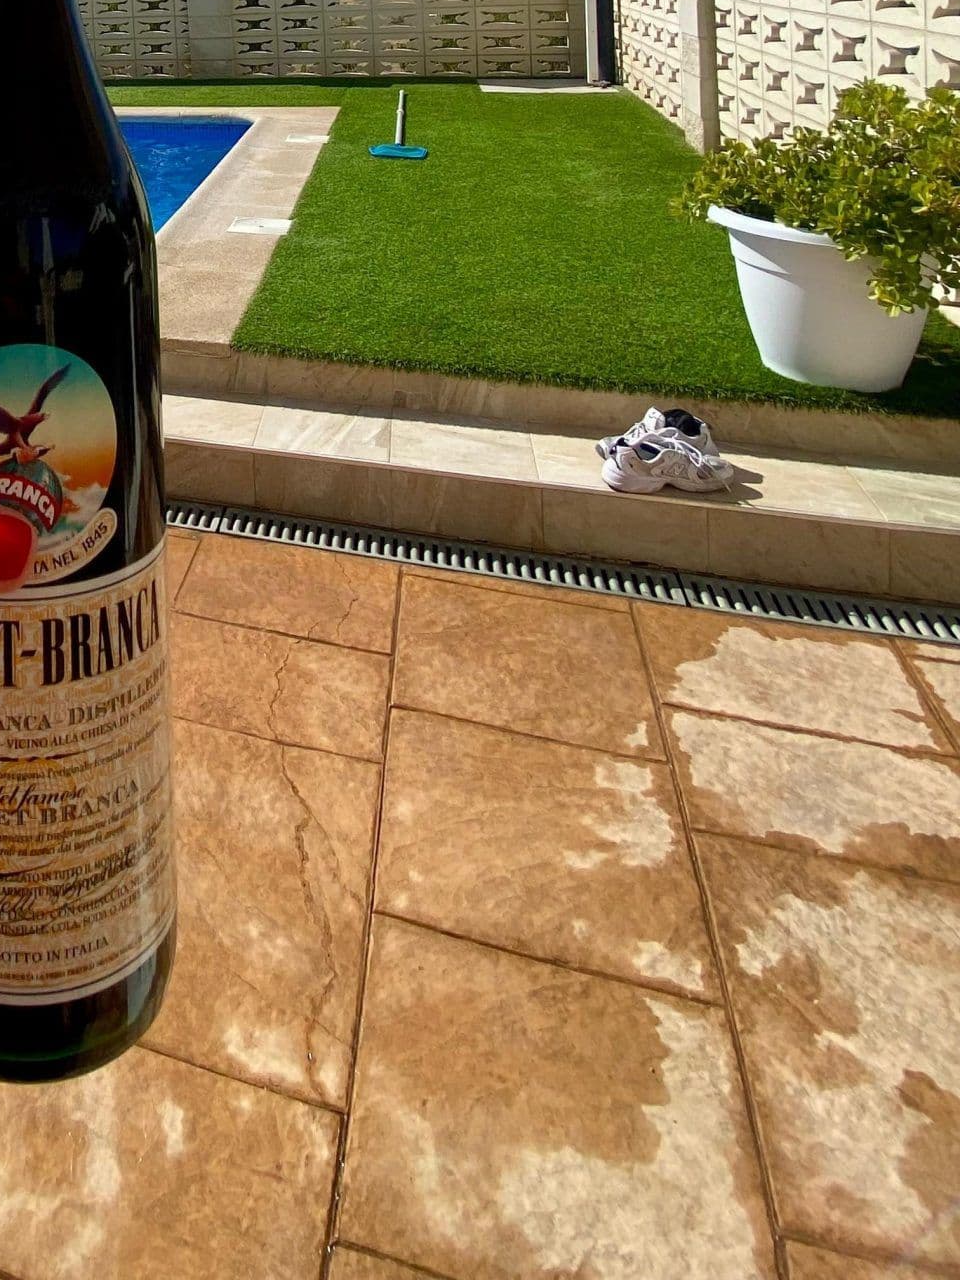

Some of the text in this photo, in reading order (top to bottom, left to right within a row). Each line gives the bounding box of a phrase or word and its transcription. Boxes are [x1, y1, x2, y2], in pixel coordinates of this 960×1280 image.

[52, 549, 80, 570] NEL
[81, 521, 108, 553] 1845
[6, 737, 48, 750] VICINO
[52, 733, 79, 747] ALLA
[81, 720, 118, 741] CHIESA
[14, 782, 87, 812] famoso
[39, 780, 139, 825] BRANCA
[46, 950, 60, 962] IN
[65, 936, 109, 959] ITALIA
